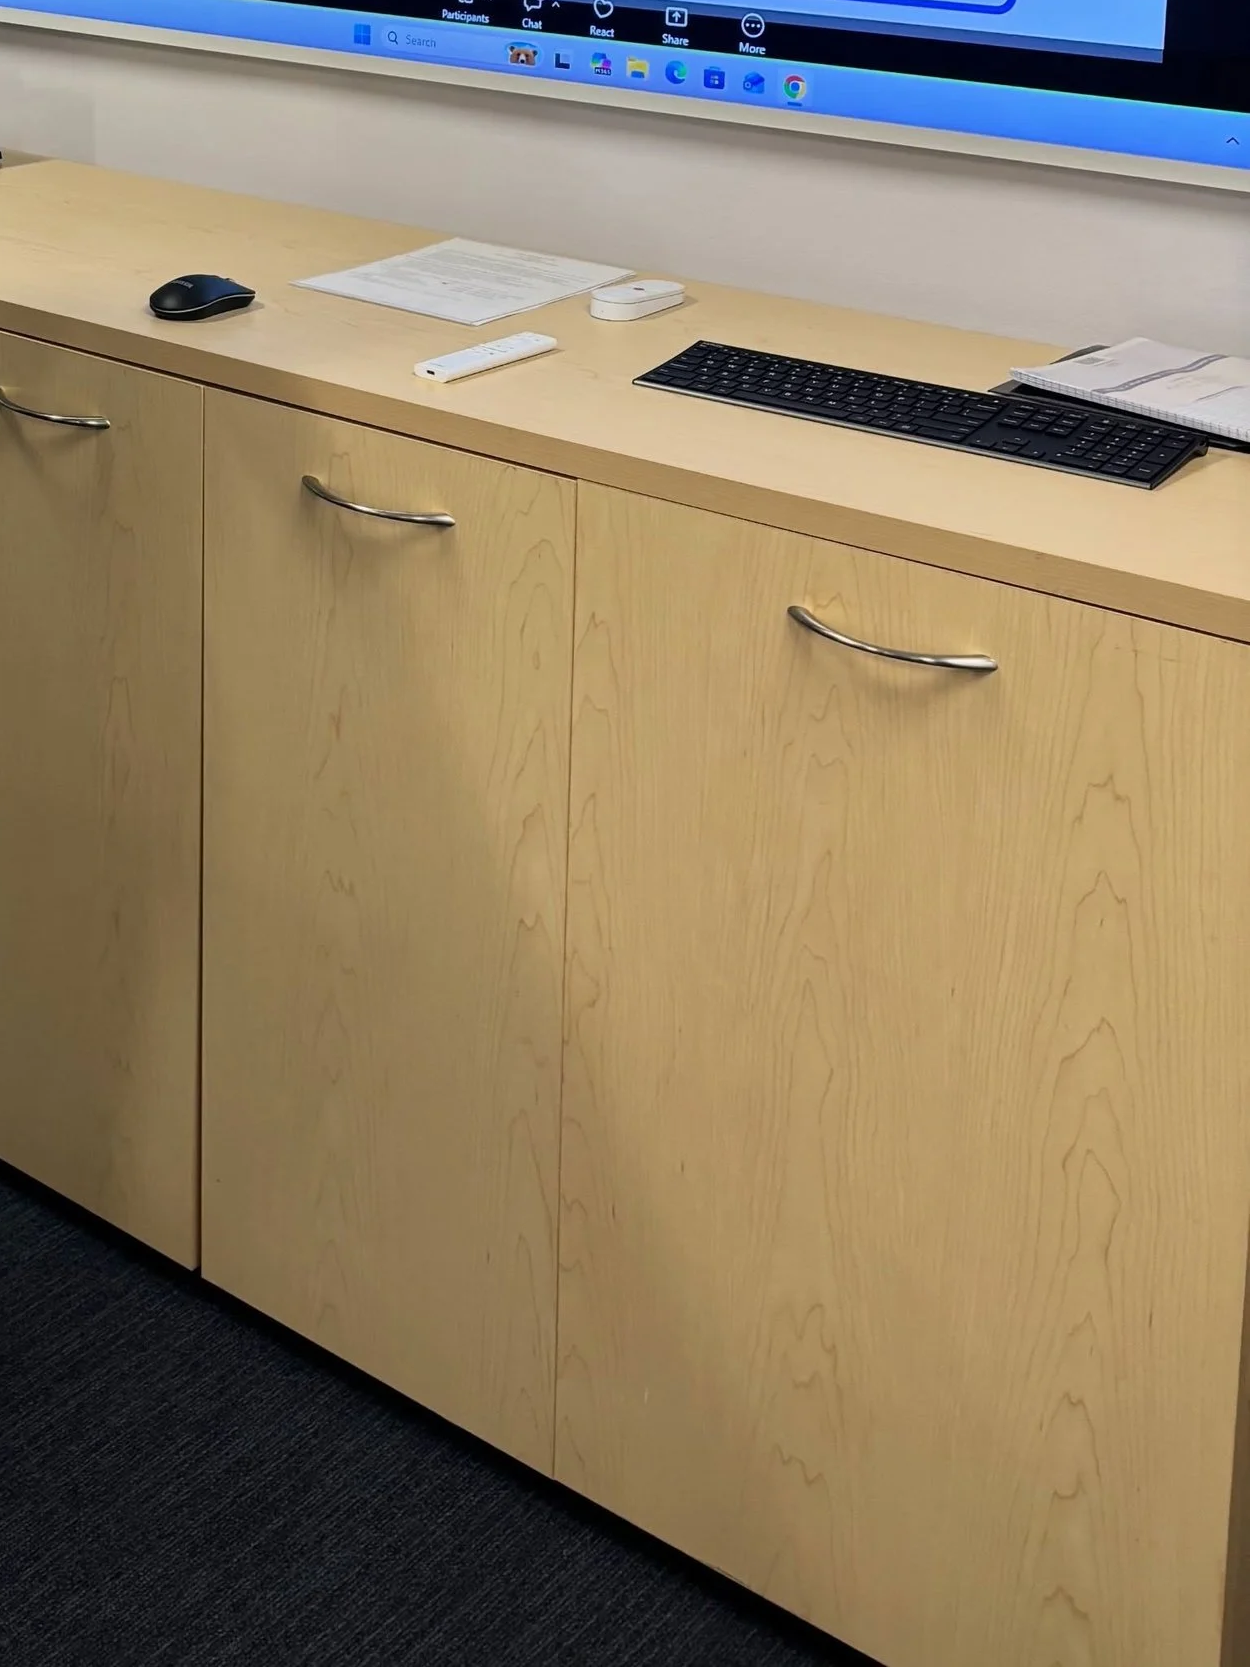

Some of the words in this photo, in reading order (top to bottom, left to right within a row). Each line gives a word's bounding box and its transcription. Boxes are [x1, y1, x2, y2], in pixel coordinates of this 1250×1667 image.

[442, 9, 490, 24] Participants
[521, 17, 543, 30] Chat
[589, 25, 615, 38] React
[405, 34, 437, 49] Search
[662, 33, 690, 47] Share
[738, 42, 766, 55] More
